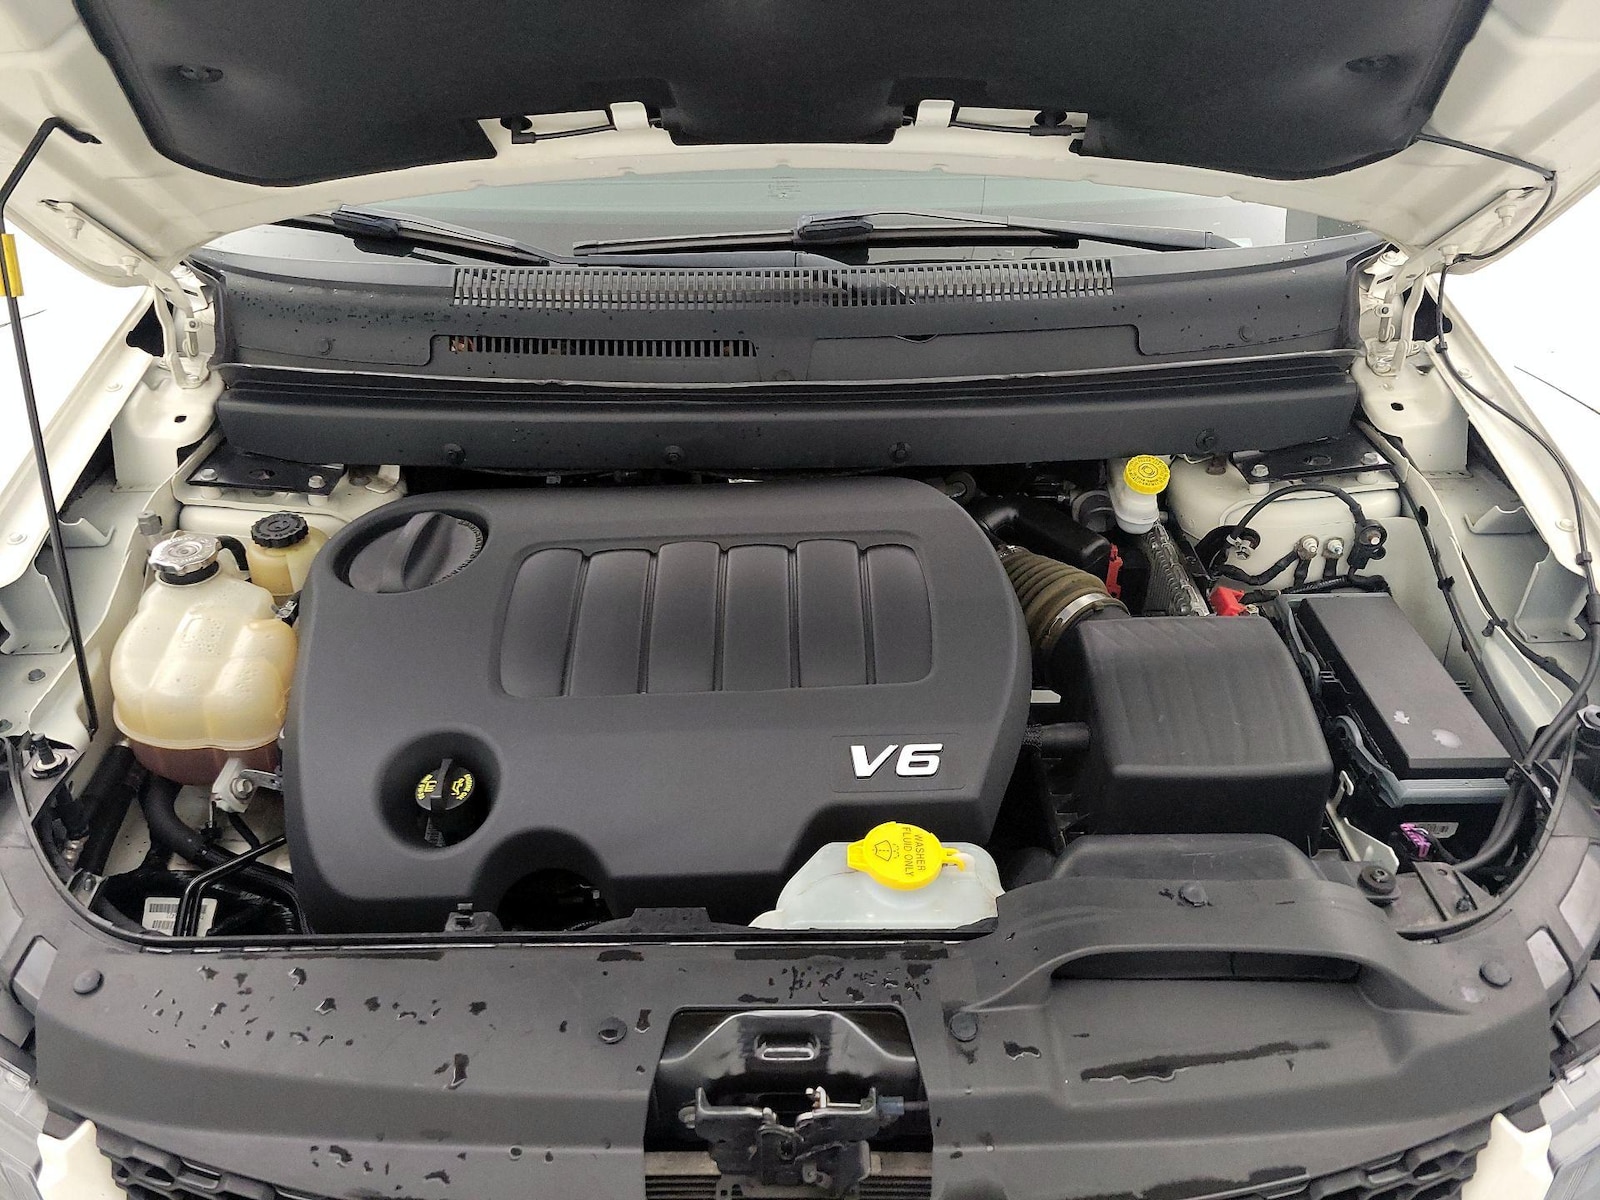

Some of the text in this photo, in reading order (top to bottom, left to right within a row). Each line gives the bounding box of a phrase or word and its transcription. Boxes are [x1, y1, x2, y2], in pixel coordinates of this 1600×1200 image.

[850, 743, 944, 778] V6
[902, 826, 915, 877] FLUID ONLY
[914, 834, 926, 871] WASHER
